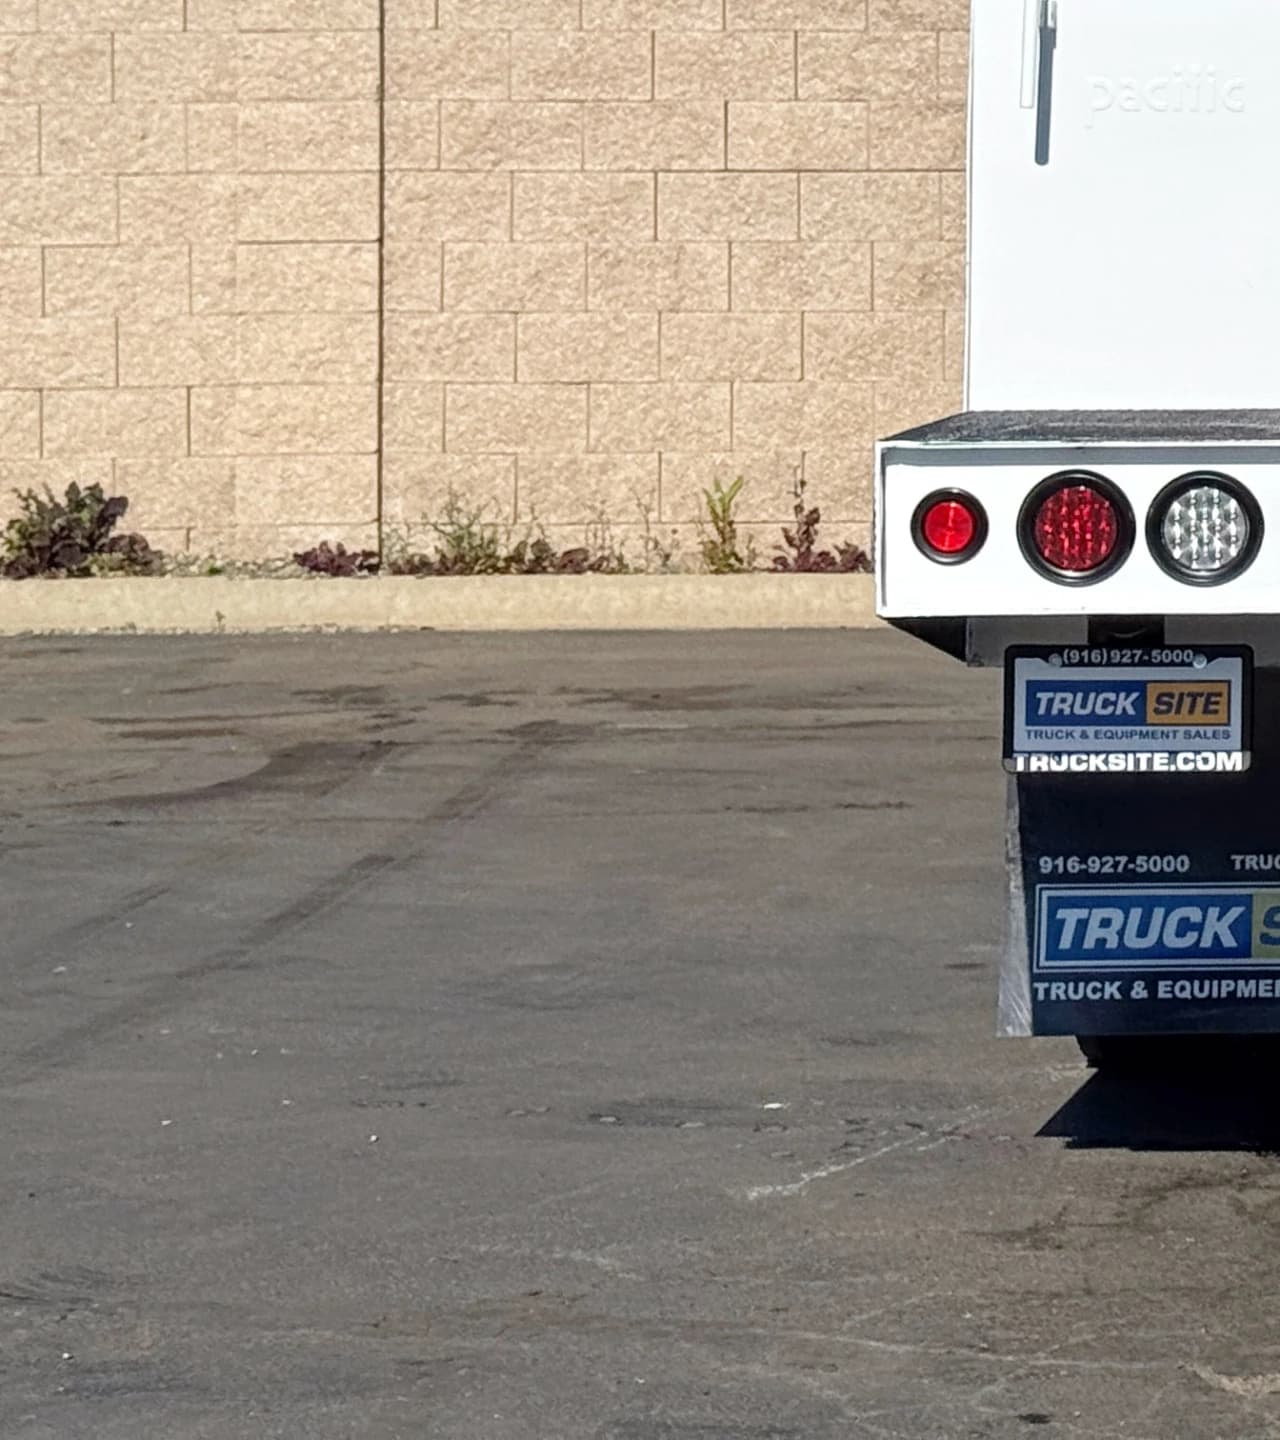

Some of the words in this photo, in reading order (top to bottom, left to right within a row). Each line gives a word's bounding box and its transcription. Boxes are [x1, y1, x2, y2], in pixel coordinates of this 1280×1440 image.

[1063, 648, 1108, 665] (916)
[1111, 648, 1195, 664] 927-5000
[1035, 691, 1141, 716] TRUCK
[1152, 691, 1224, 716] SITE
[1025, 729, 1077, 741] TRUCK
[1079, 729, 1090, 740] &
[1094, 729, 1180, 741] EQUIPMENT
[1183, 729, 1231, 740] SALES
[1013, 751, 1243, 772] TRUCKSITE.COM
[1038, 855, 1191, 874] 916-927-5000
[1055, 906, 1247, 950] TRUCK
[1034, 981, 1122, 1001] TRUCK
[1130, 981, 1149, 999] &
